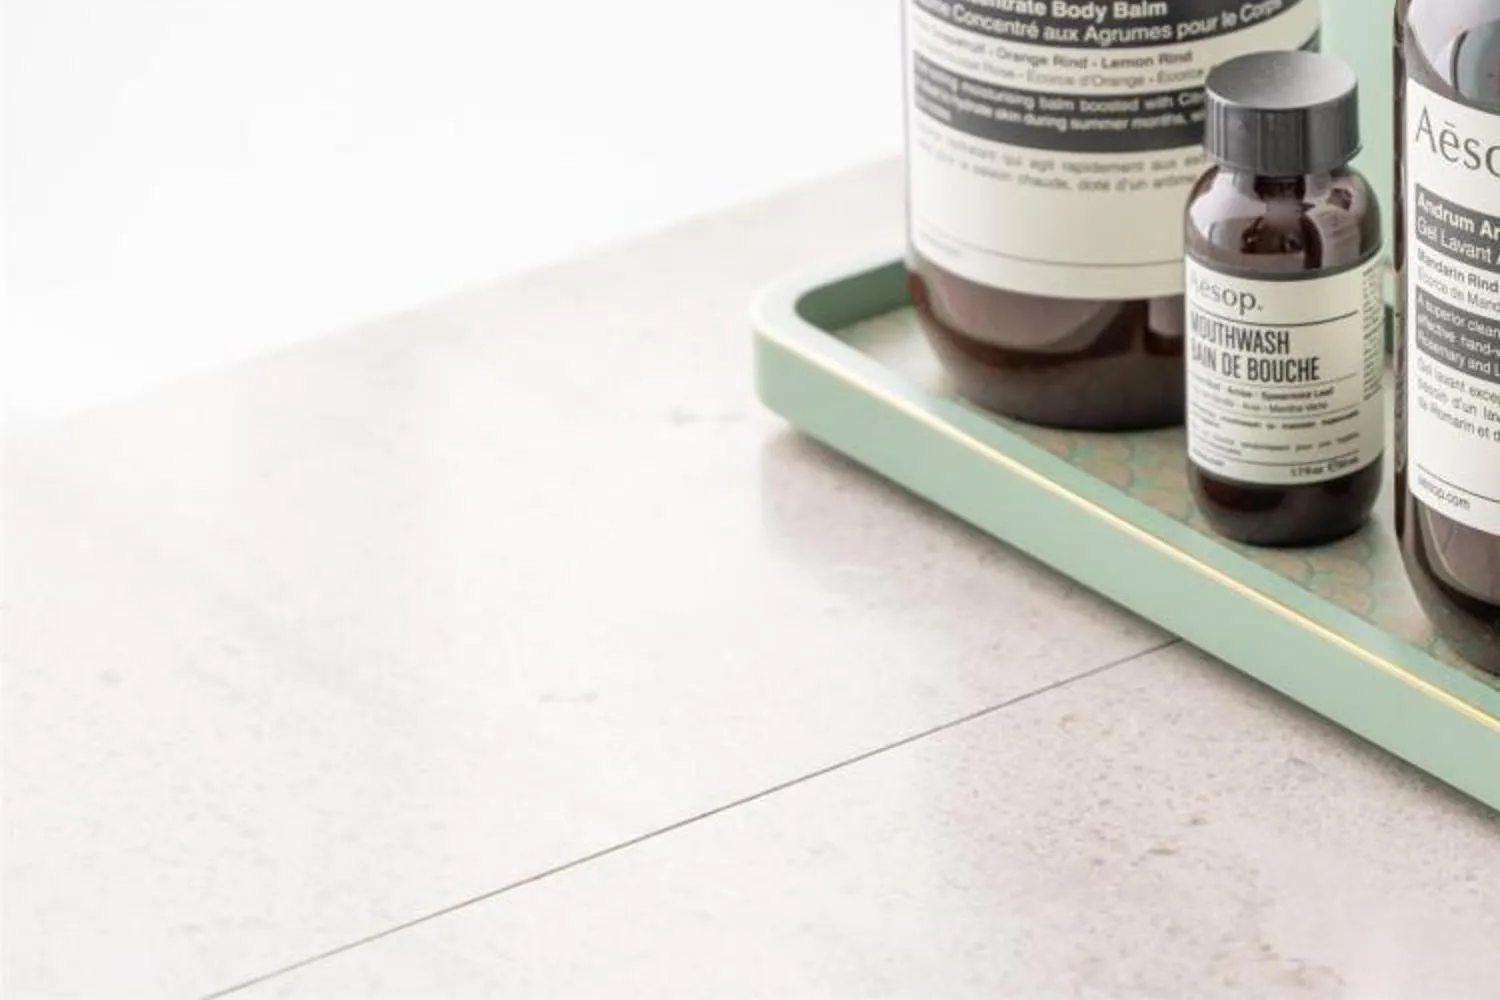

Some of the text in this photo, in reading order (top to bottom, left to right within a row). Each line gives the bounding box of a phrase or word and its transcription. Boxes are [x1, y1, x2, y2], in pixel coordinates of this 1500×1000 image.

[952, 2, 1040, 40] Concentré
[1043, 25, 1080, 41] aux
[1084, 24, 1174, 47] Agrumes
[1176, 17, 1219, 40] pour
[1221, 9, 1237, 29] le
[1051, 0, 1108, 24] Body
[1113, 0, 1168, 19] Balm
[1101, 56, 1155, 70] Lemon
[1417, 190, 1476, 234] Andrum
[1417, 214, 1438, 241] Gel
[1440, 228, 1493, 264] Lavant
[1466, 272, 1499, 294] Rind
[1221, 351, 1242, 379] DE
[1247, 355, 1321, 384] BOUCHE
[1466, 357, 1492, 375] and
